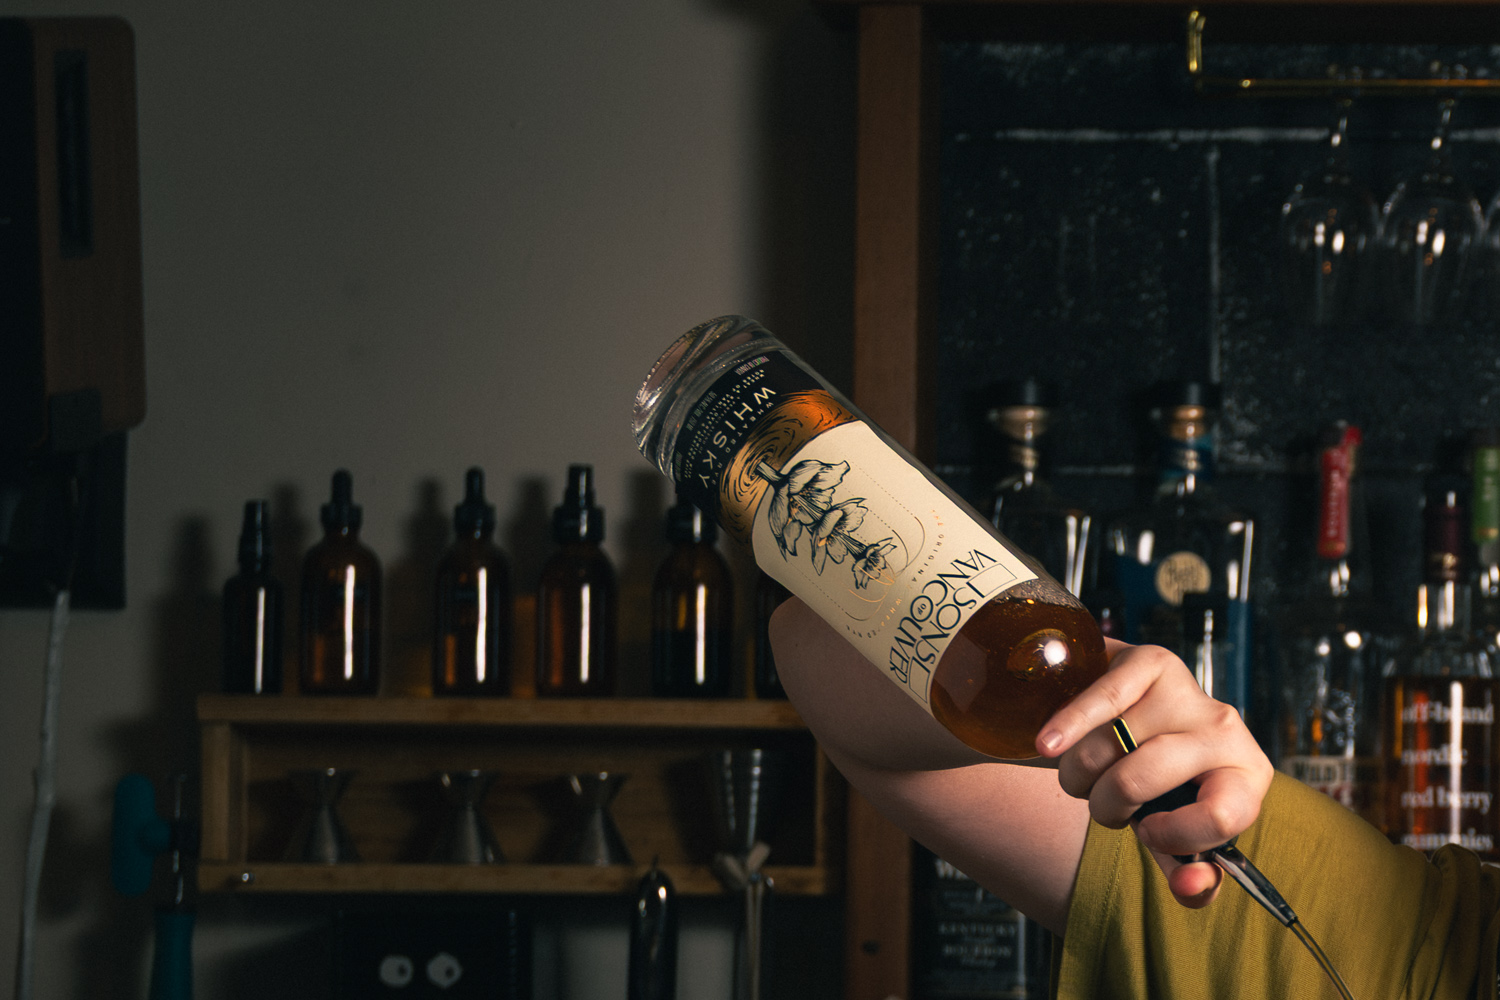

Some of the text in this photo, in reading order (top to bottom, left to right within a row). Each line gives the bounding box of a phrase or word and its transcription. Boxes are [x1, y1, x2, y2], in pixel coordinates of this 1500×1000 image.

[697, 386, 777, 489] WHISKY
[710, 401, 774, 486] WHEATED RYE
[889, 548, 997, 683] VANCOUVER
[1402, 700, 1494, 724] off-band
[1402, 743, 1469, 765] nordc
[1436, 786, 1493, 816] brry
